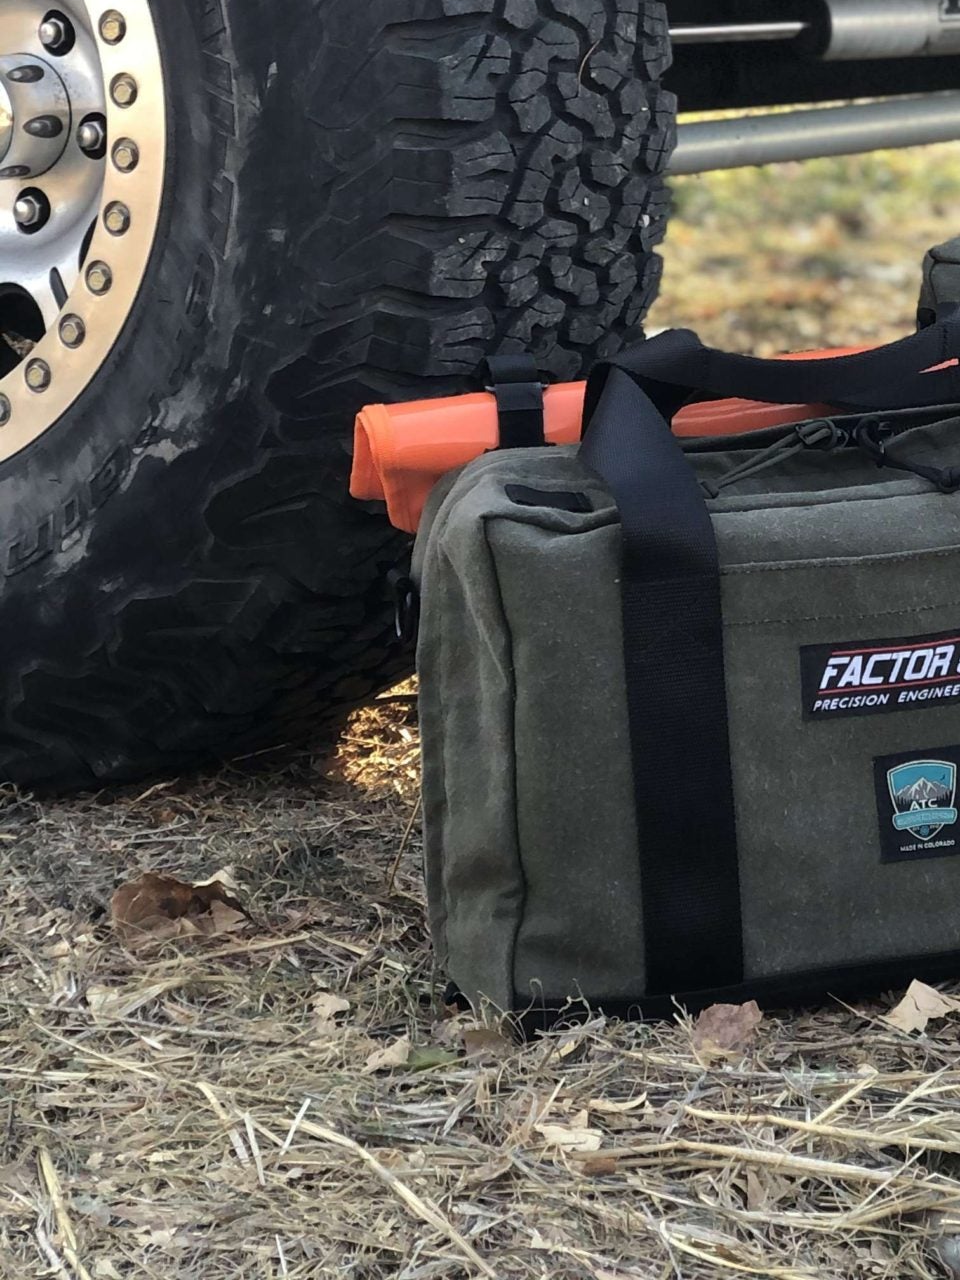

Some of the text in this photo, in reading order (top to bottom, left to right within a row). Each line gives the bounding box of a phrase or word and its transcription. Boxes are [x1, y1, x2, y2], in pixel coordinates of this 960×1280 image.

[819, 644, 955, 690] FACTOR
[813, 693, 890, 711] PRECISION
[911, 799, 938, 811] ATC
[924, 839, 955, 849] COLORADO
